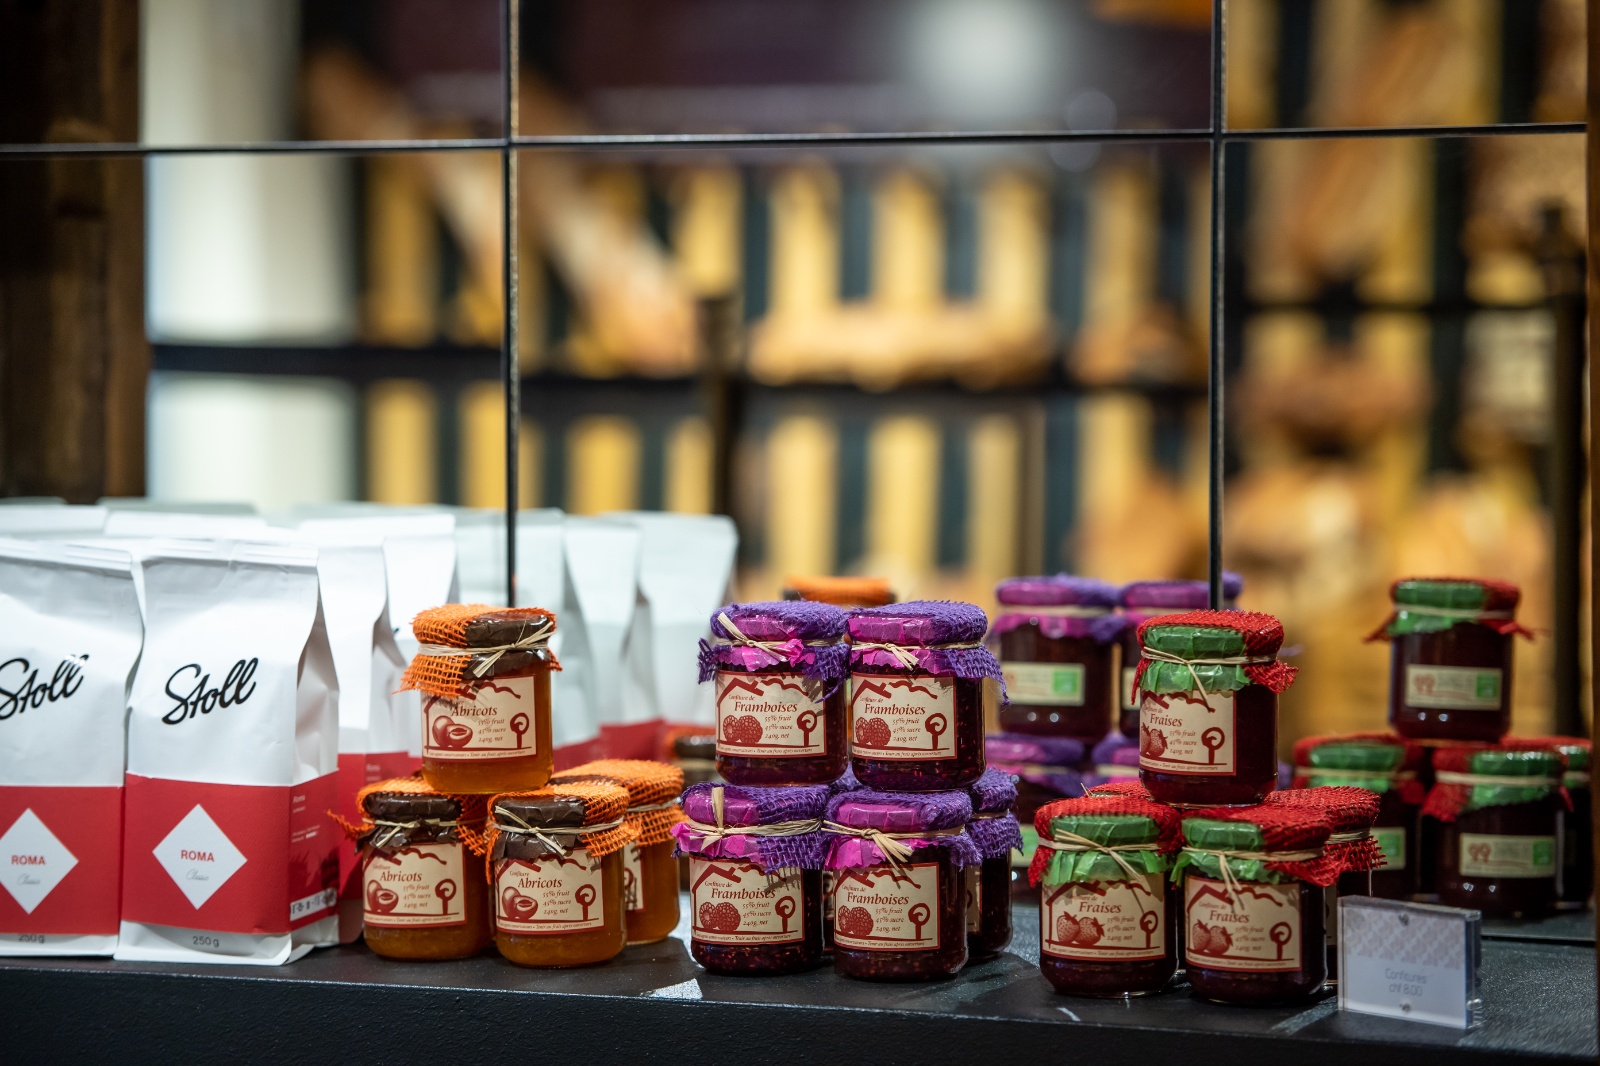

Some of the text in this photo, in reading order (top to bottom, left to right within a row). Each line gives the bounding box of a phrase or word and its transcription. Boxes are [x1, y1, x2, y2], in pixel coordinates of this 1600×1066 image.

[0, 654, 88, 720] Stoll
[162, 657, 258, 725] Stoll
[451, 705, 497, 716] Abricots
[734, 701, 798, 712] Framboises
[864, 703, 926, 715] Framboises
[491, 718, 505, 727] fruit
[778, 715, 792, 723] fruit
[905, 718, 920, 726] fruit
[1150, 713, 1183, 727] Fraises
[1182, 730, 1196, 738] fruit
[11, 854, 46, 866] ROMA
[180, 849, 215, 862] ROMA
[380, 870, 423, 882] Abricots
[416, 884, 430, 893] fruit
[518, 877, 563, 889] Abricots
[543, 890, 570, 898] 55% fruit
[711, 888, 776, 899] Framboises
[847, 892, 910, 905] Framboises
[755, 902, 770, 910] fruit
[1078, 901, 1122, 914] Fraises
[889, 908, 903, 916] fruit
[1209, 909, 1250, 923] Fraises
[1120, 916, 1135, 924] fruit
[18, 934, 45, 944] 250 g
[192, 935, 220, 948] 250 g
[1385, 968, 1427, 985] Confitures
